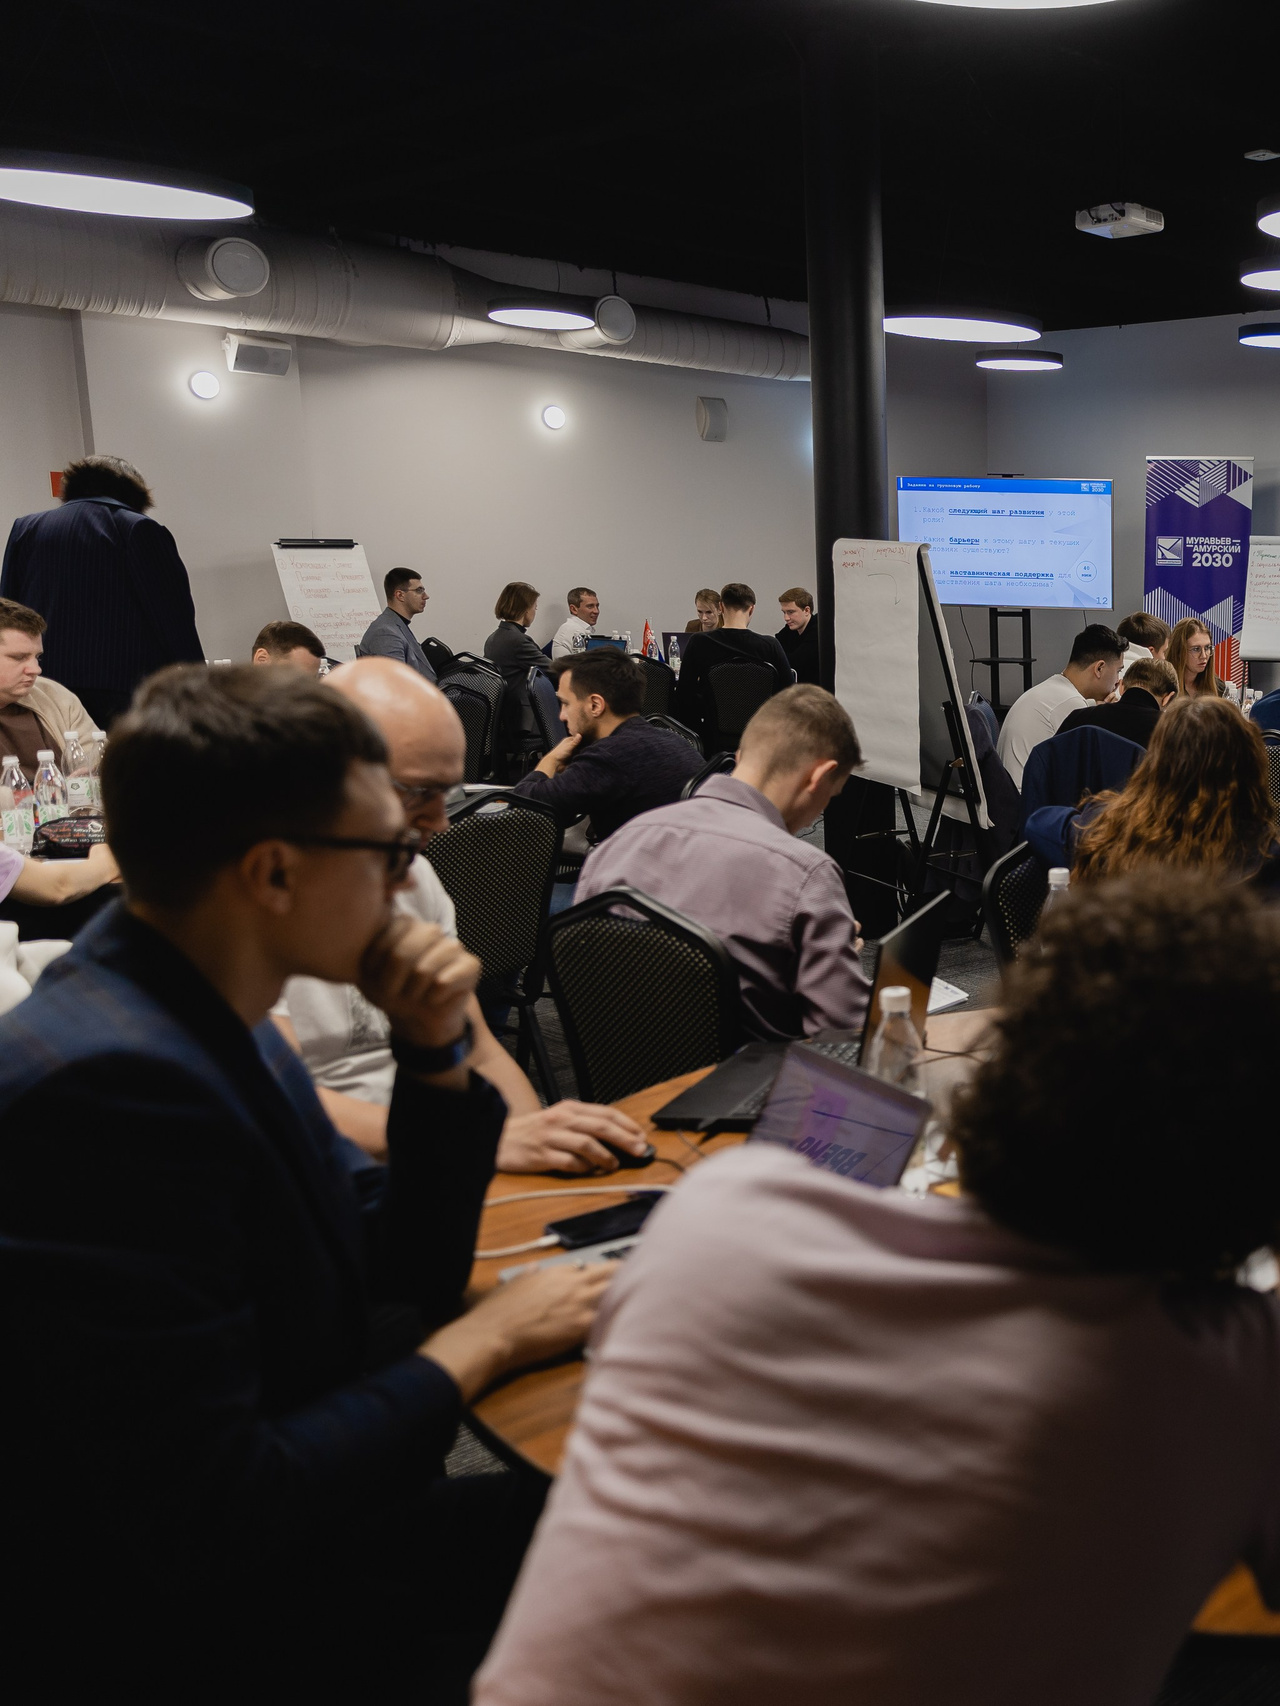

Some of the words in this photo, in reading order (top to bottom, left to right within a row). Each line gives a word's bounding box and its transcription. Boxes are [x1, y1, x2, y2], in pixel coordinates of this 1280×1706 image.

[949, 506, 988, 515] следующий
[923, 516, 945, 524] роли?
[949, 536, 980, 544] барьеры
[1192, 552, 1234, 568] 2030
[1015, 571, 1054, 579] поддержка
[1007, 580, 1054, 588] необходима?
[1096, 596, 1109, 605] 12
